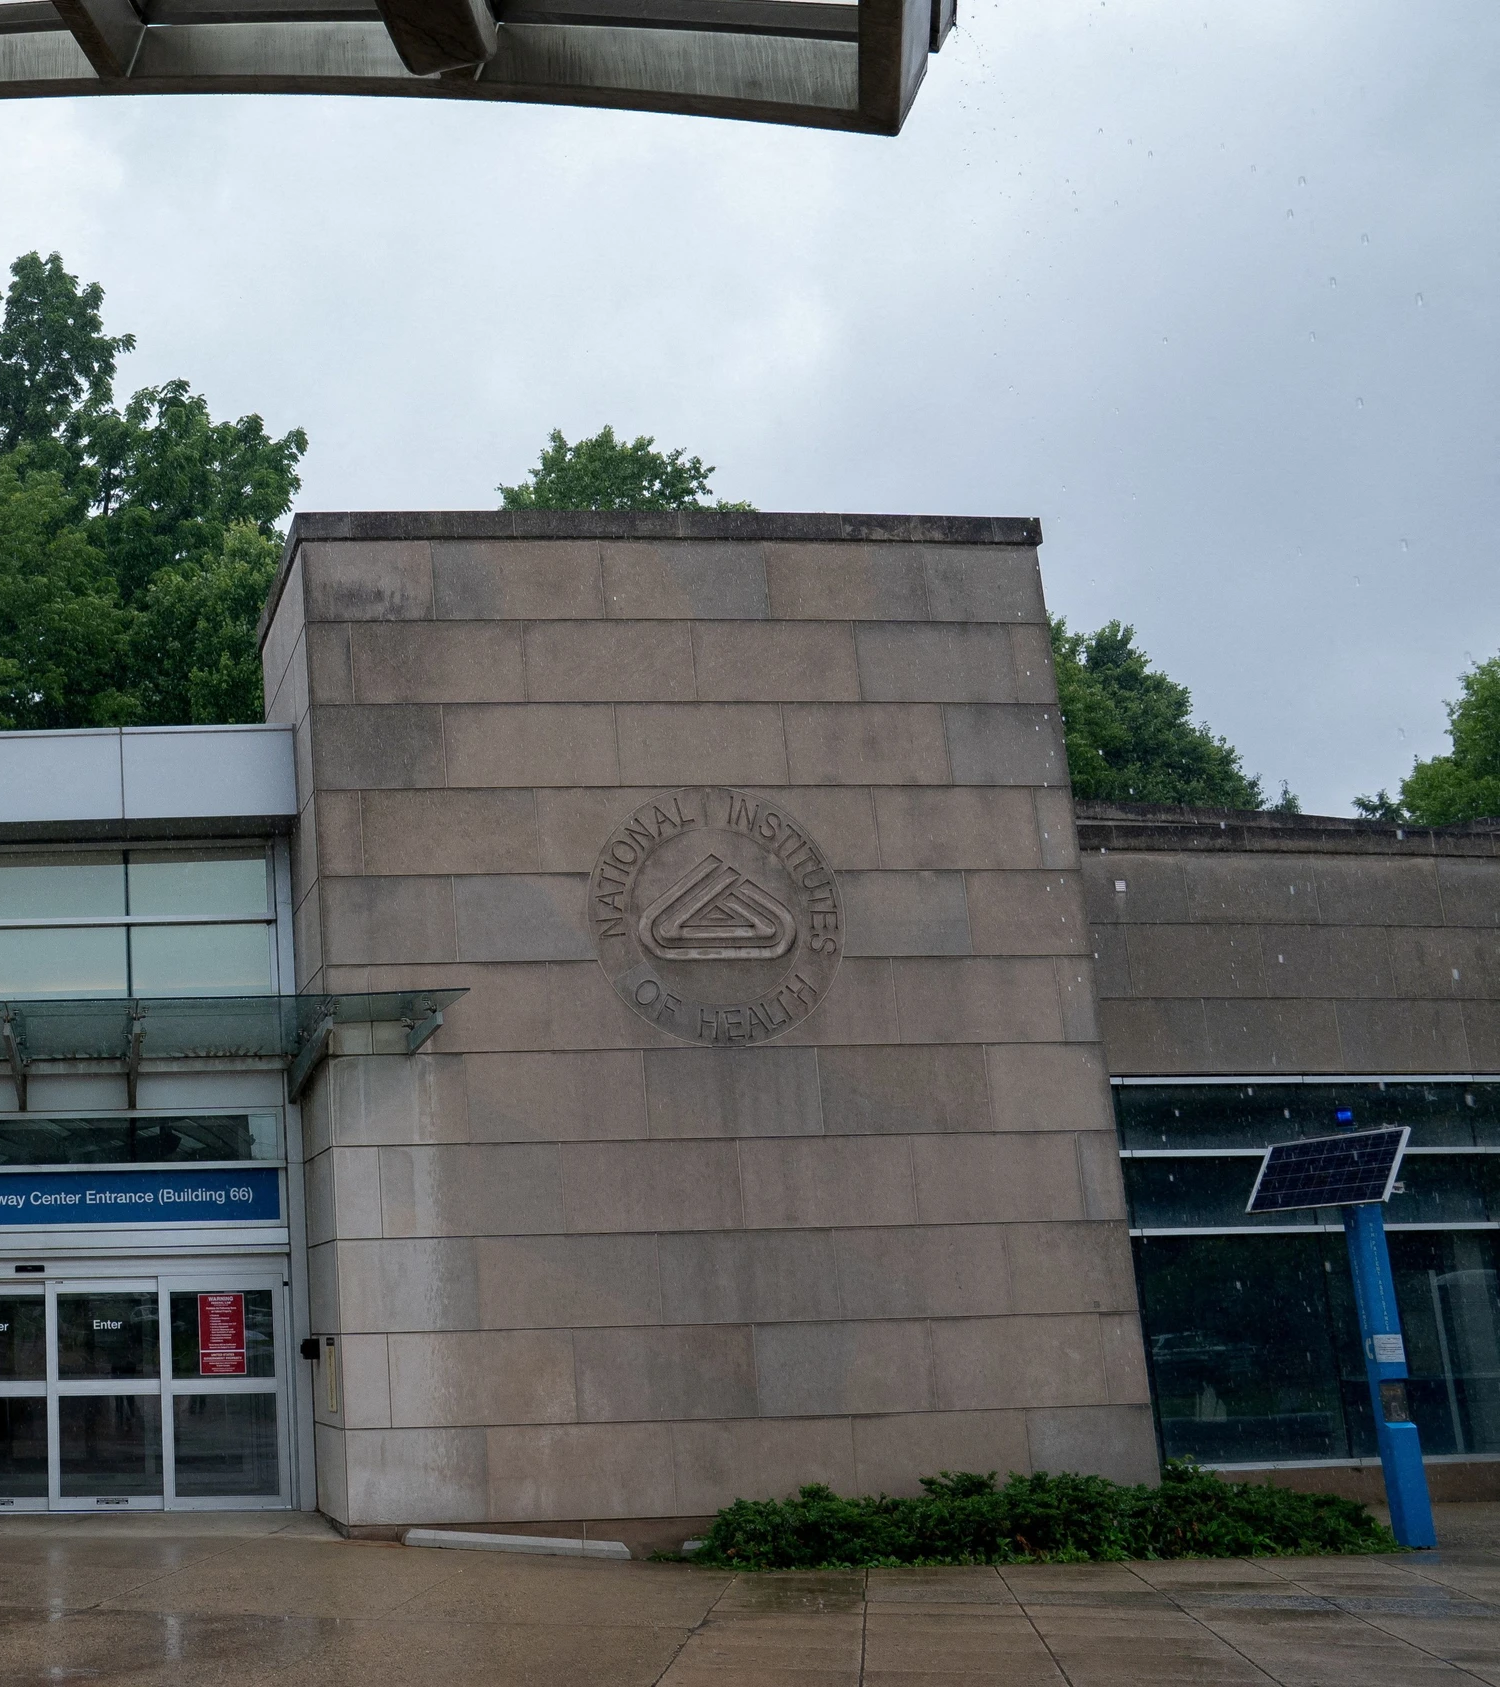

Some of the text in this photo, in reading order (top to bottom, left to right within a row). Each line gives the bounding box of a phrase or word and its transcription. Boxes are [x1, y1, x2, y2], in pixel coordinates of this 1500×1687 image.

[595, 796, 838, 956] NATIONAL INSTITUTES
[634, 973, 818, 1040] OF HEALTH
[30, 1192, 81, 1206] Center
[85, 1190, 154, 1204] Entrance
[158, 1188, 226, 1206] (Building
[229, 1187, 253, 1203] 66)
[92, 1319, 122, 1330] Enter
[1378, 1280, 1390, 1332] ASSISTANCE
